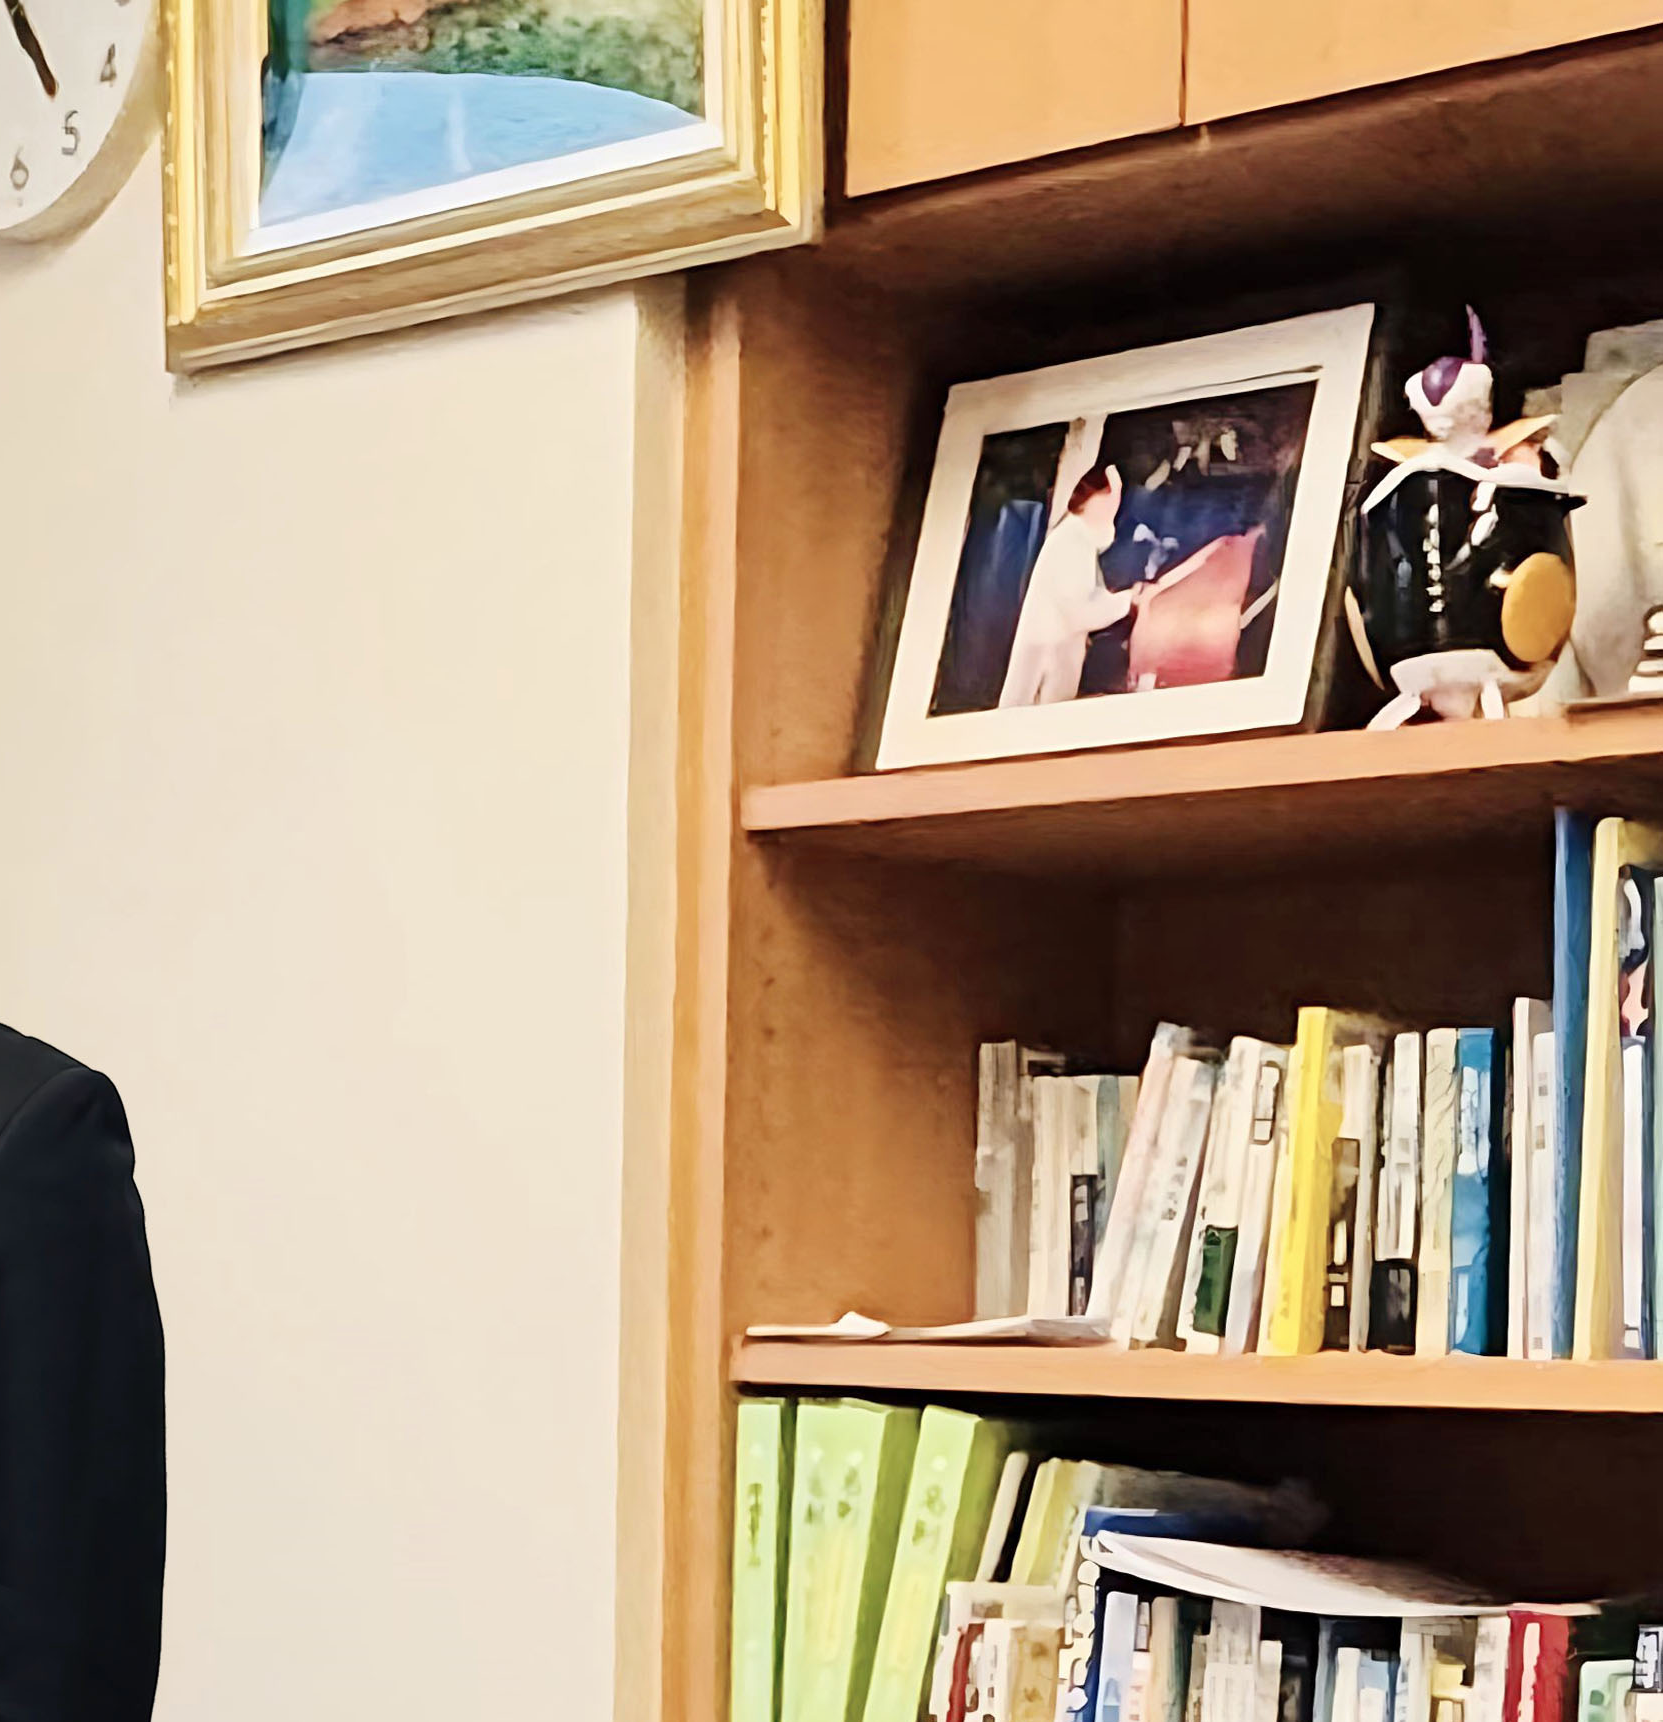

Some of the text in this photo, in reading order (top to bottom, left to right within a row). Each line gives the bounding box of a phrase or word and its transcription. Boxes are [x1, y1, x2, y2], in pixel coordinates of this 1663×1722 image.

[99, 43, 118, 87] 4
[60, 109, 81, 157] 5
[9, 148, 30, 191] 6
